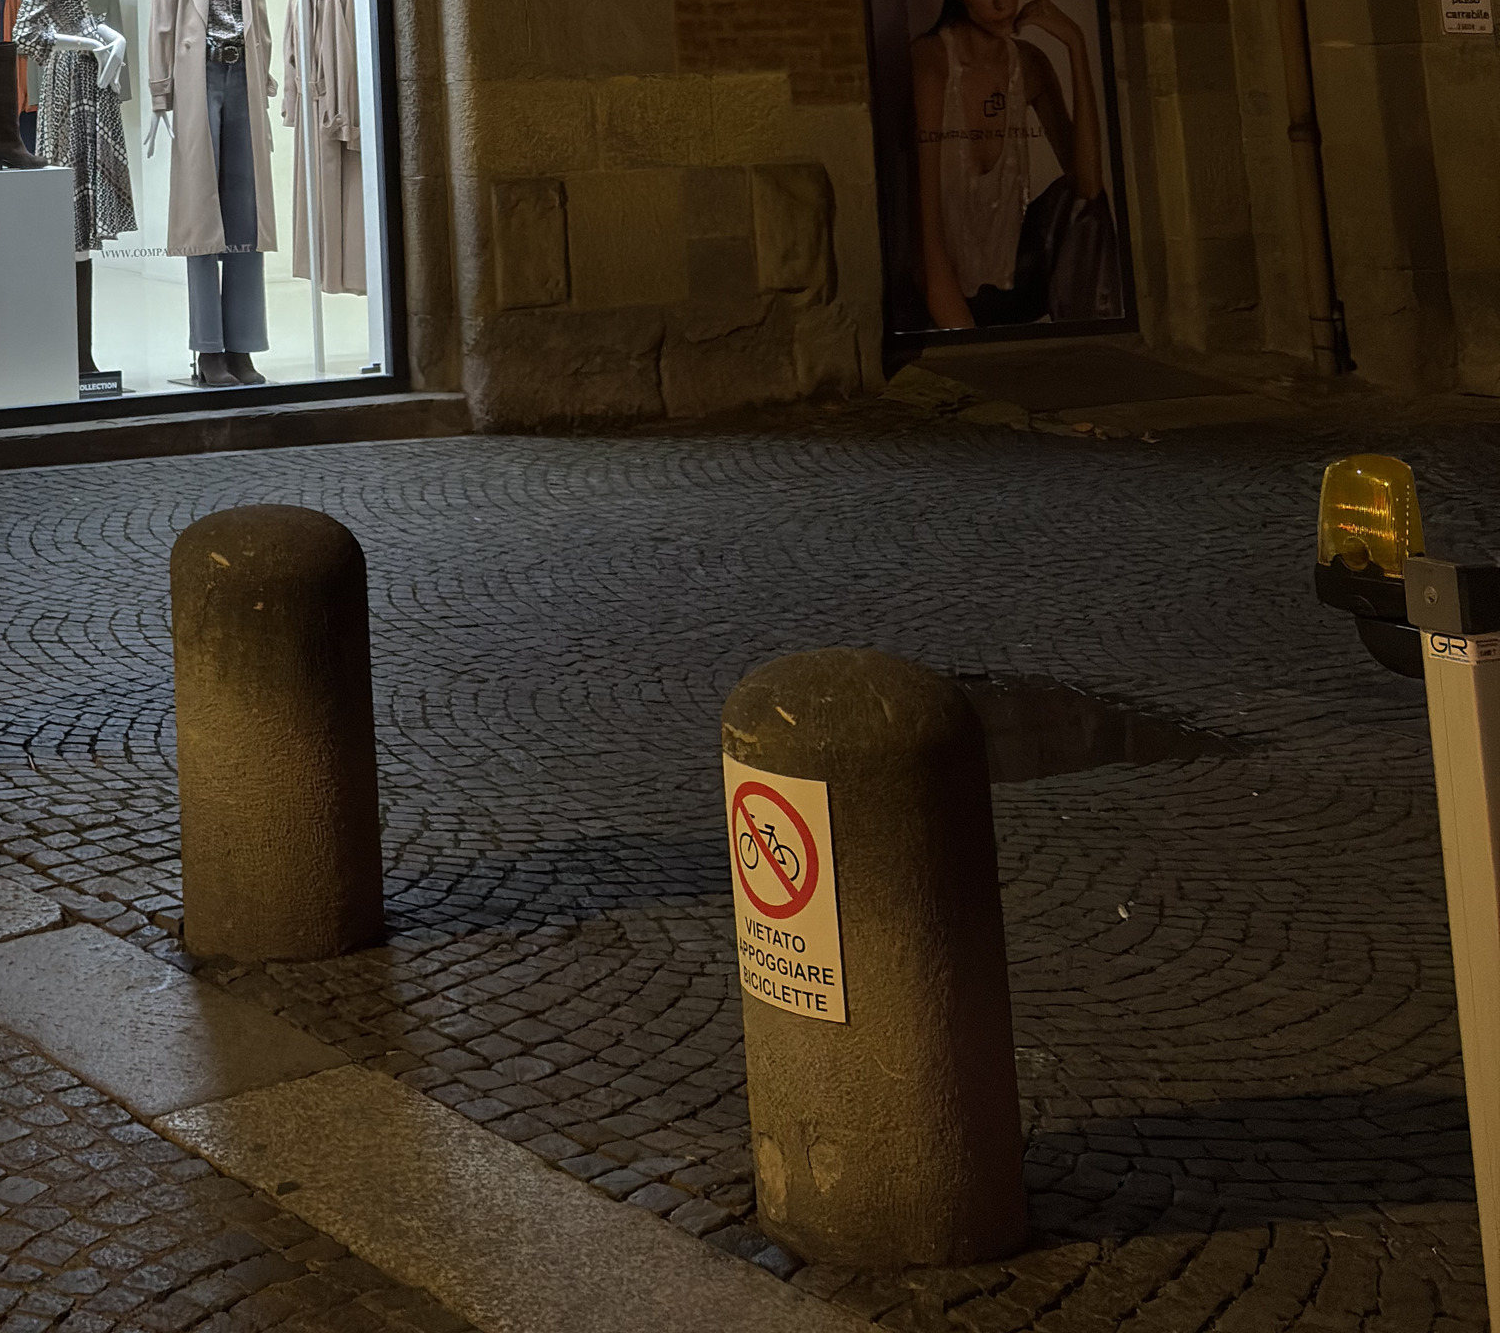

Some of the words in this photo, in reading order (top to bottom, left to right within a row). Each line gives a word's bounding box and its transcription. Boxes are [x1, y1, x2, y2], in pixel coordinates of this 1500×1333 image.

[1445, 9, 1490, 19] carrabile
[79, 381, 117, 392] OLLECTION
[744, 916, 806, 953] VIETATO
[739, 936, 835, 986] APPOGGIARE
[743, 965, 828, 1012] BICICLETTE
